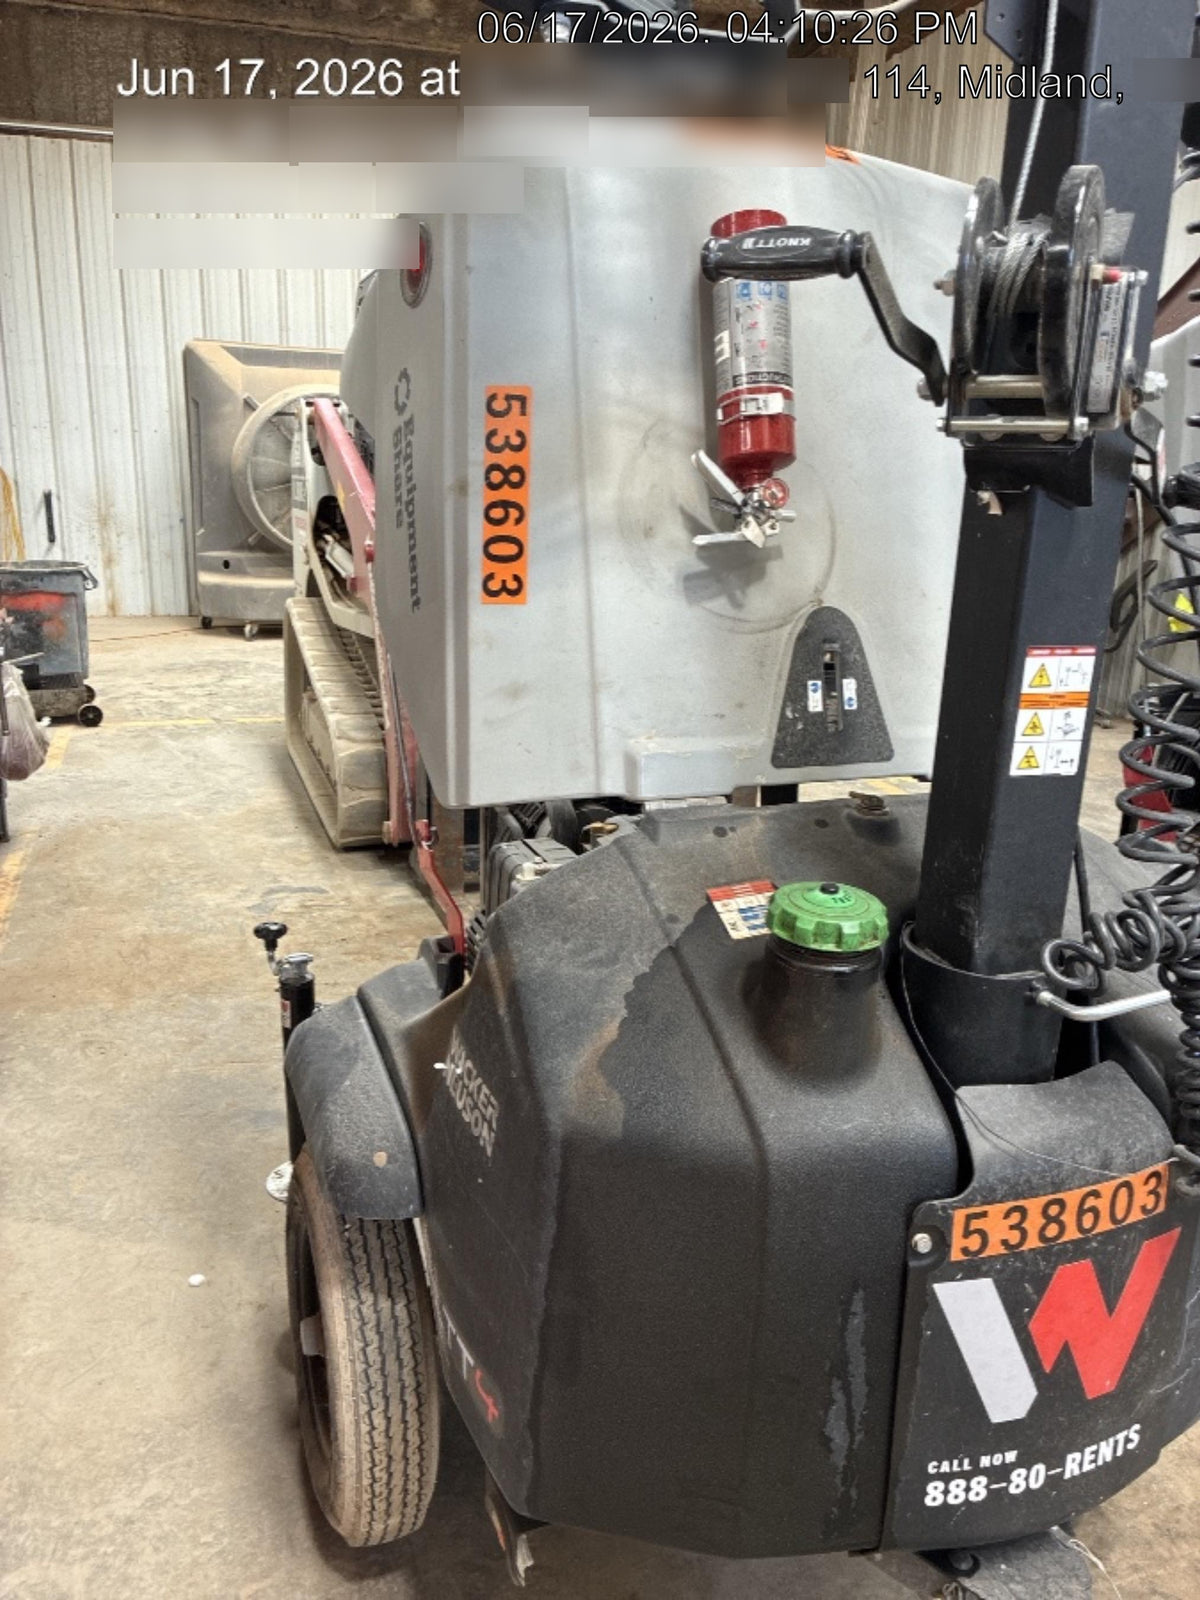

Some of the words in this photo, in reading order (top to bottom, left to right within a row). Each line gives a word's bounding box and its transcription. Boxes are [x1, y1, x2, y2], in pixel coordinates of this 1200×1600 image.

[755, 236, 813, 249] KNOTT
[391, 424, 404, 529] Share
[403, 413, 422, 613] Equipment
[482, 391, 527, 599] 538603
[959, 1170, 1165, 1259] 538603
[924, 1423, 1142, 1507] 888-80-RENTS
[927, 1457, 973, 1475] CALL
[979, 1450, 1018, 1468] NOW
